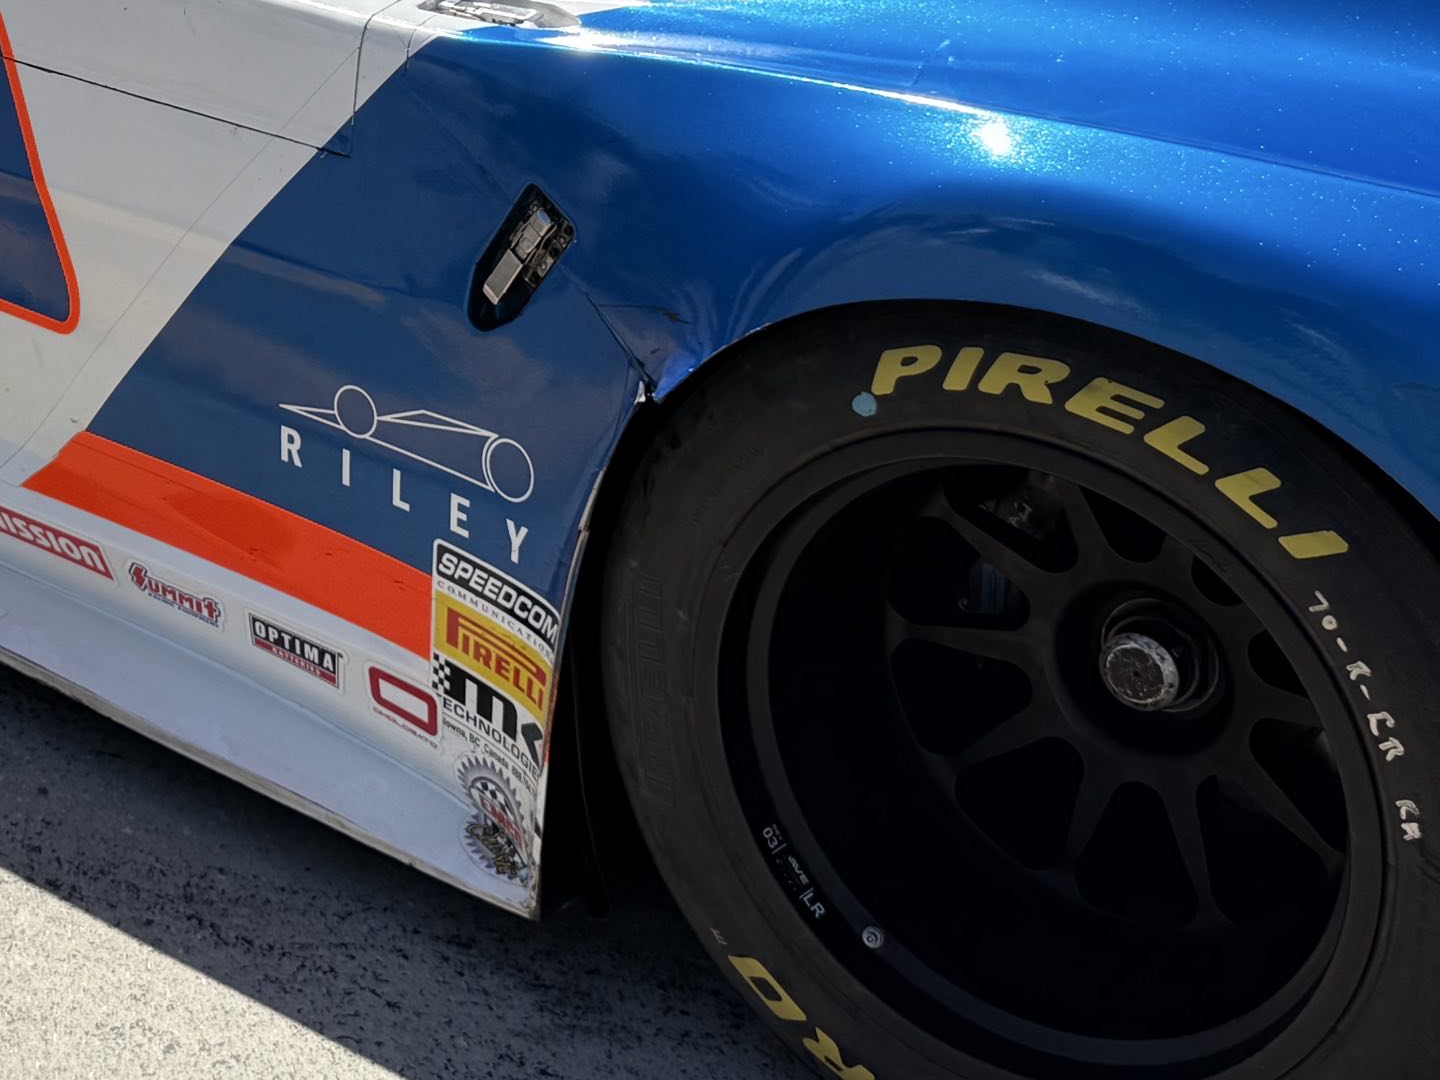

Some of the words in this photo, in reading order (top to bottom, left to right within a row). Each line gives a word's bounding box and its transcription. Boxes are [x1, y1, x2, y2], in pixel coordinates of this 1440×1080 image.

[280, 424, 529, 564] RILEY
[871, 344, 1349, 560] PIRELLI
[254, 620, 335, 673] OPTIMA
[438, 552, 559, 644] SPEEDCOM
[445, 606, 547, 713] PIRELLI
